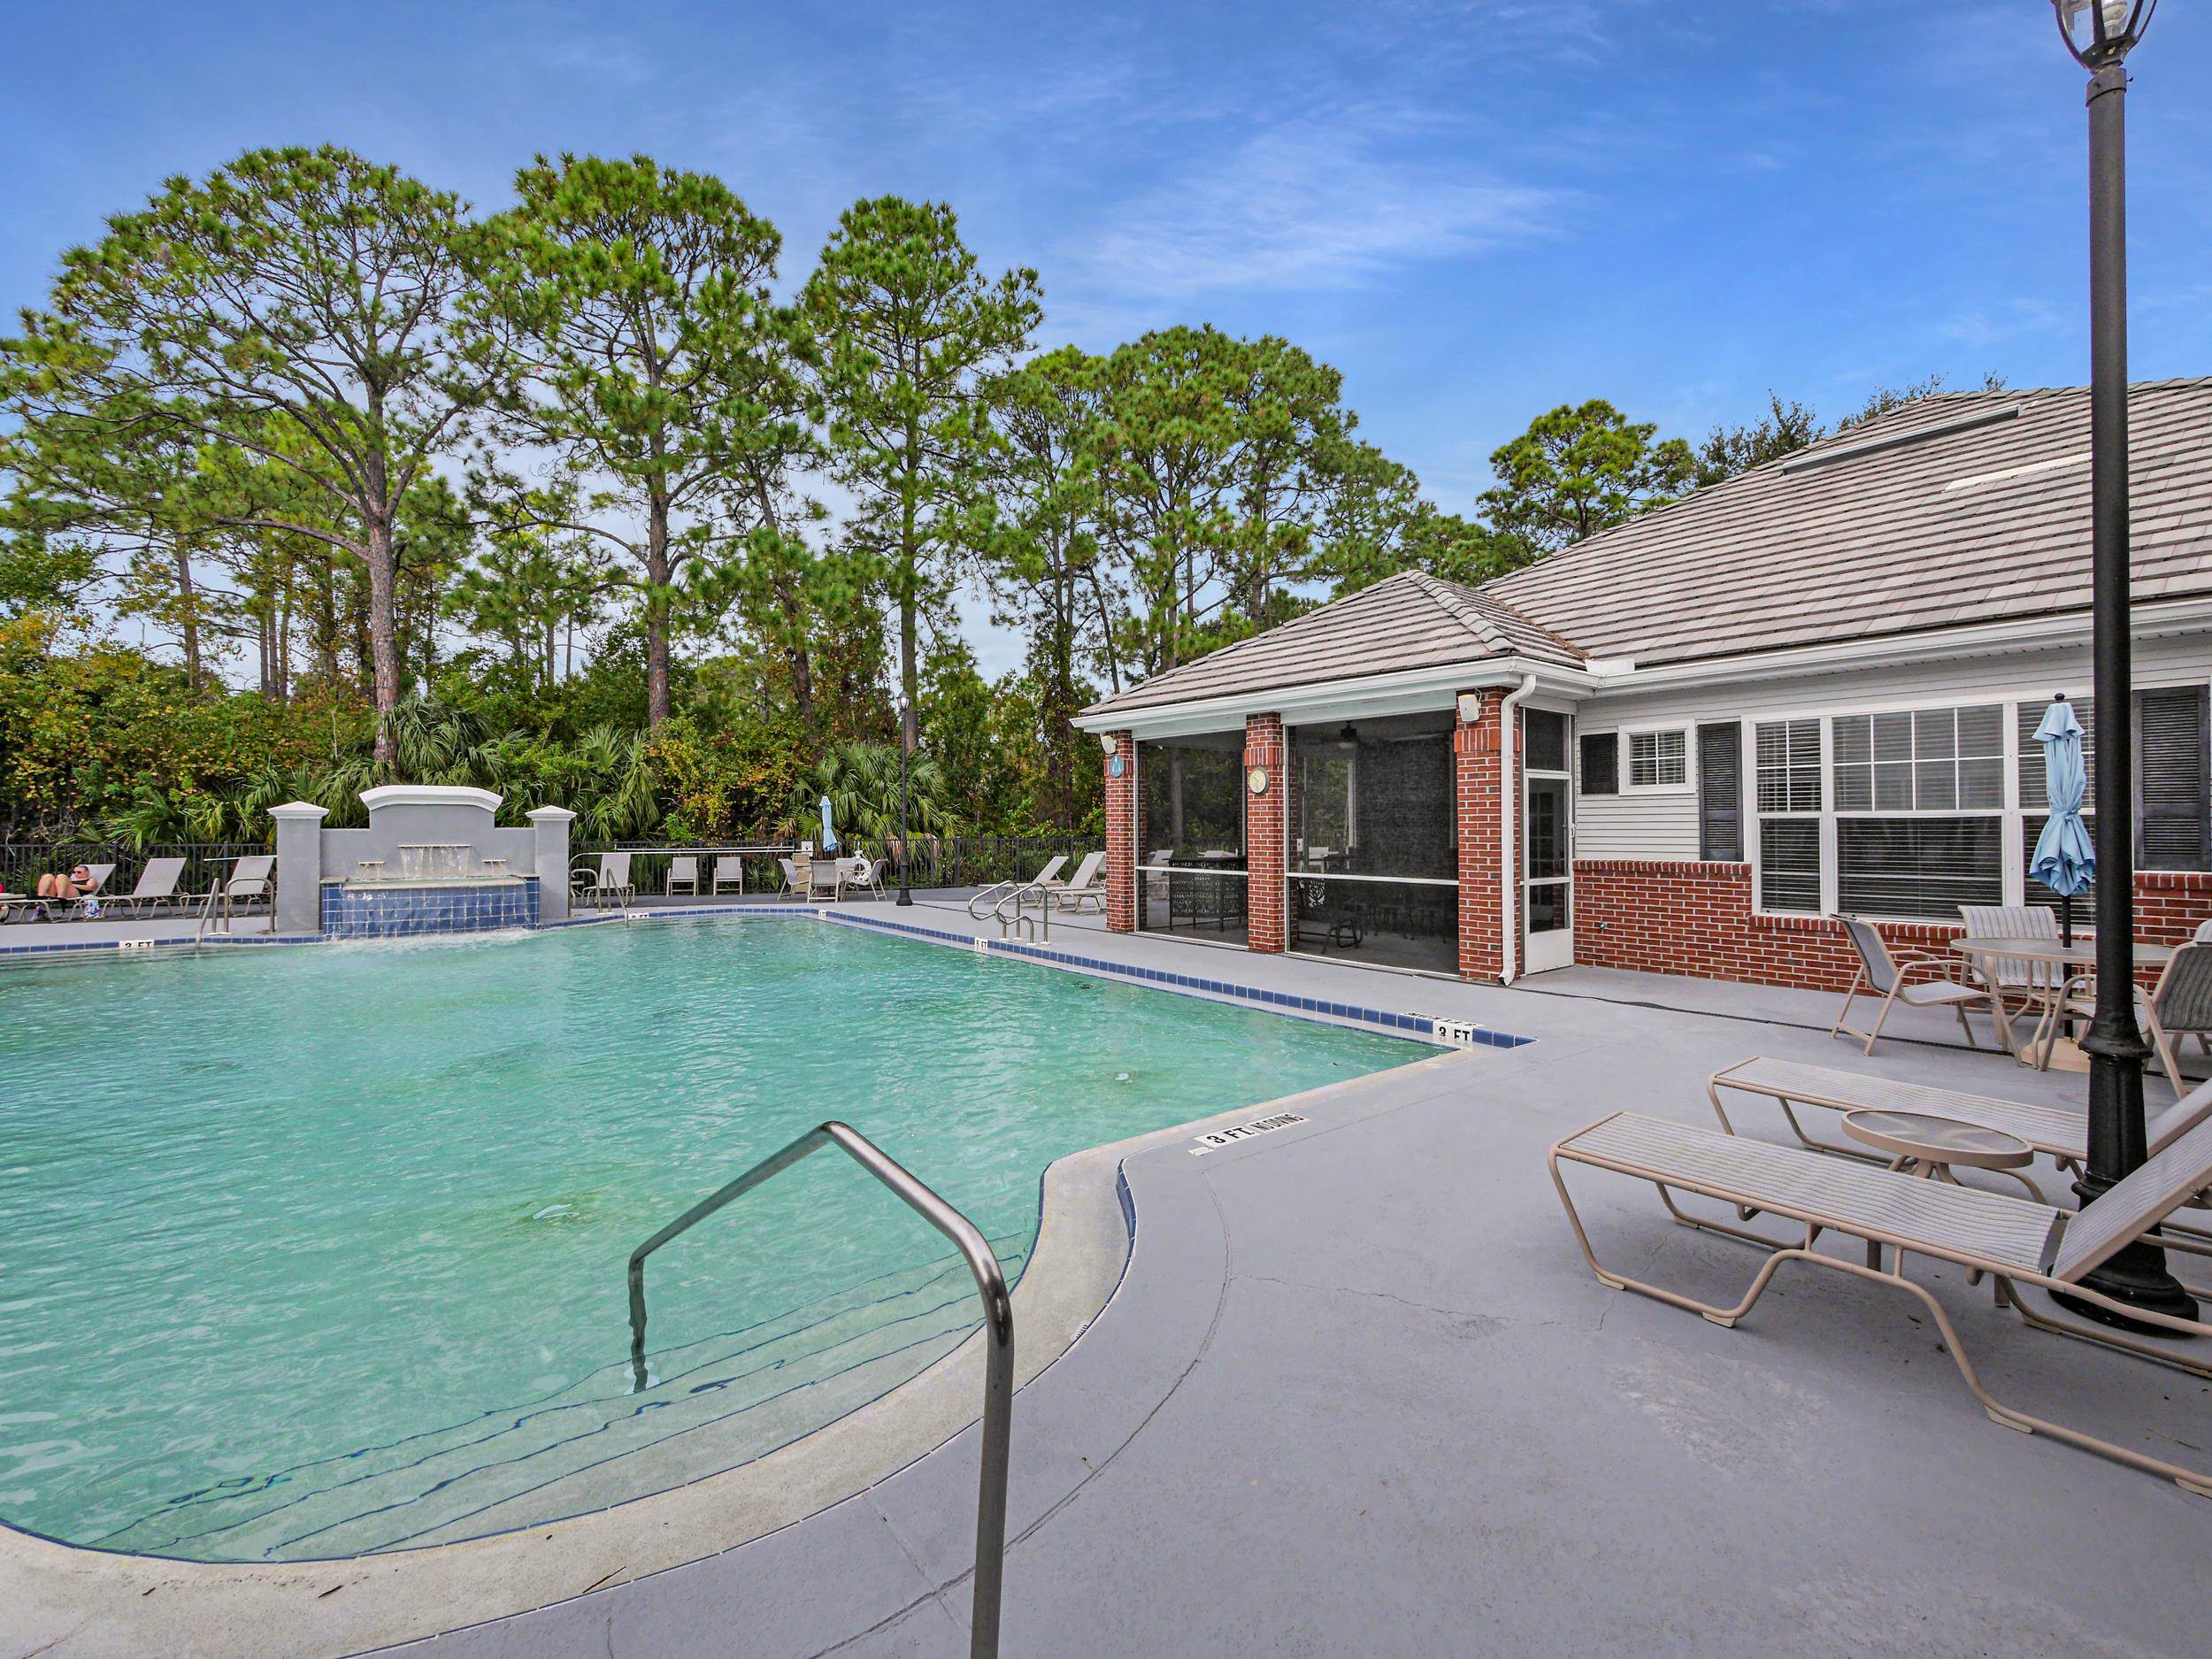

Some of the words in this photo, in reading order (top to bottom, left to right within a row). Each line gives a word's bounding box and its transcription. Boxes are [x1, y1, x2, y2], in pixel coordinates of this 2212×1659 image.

[1439, 1026, 1447, 1037] 3
[1454, 1028, 1471, 1041] FT
[1207, 1135, 1226, 1144] 3
